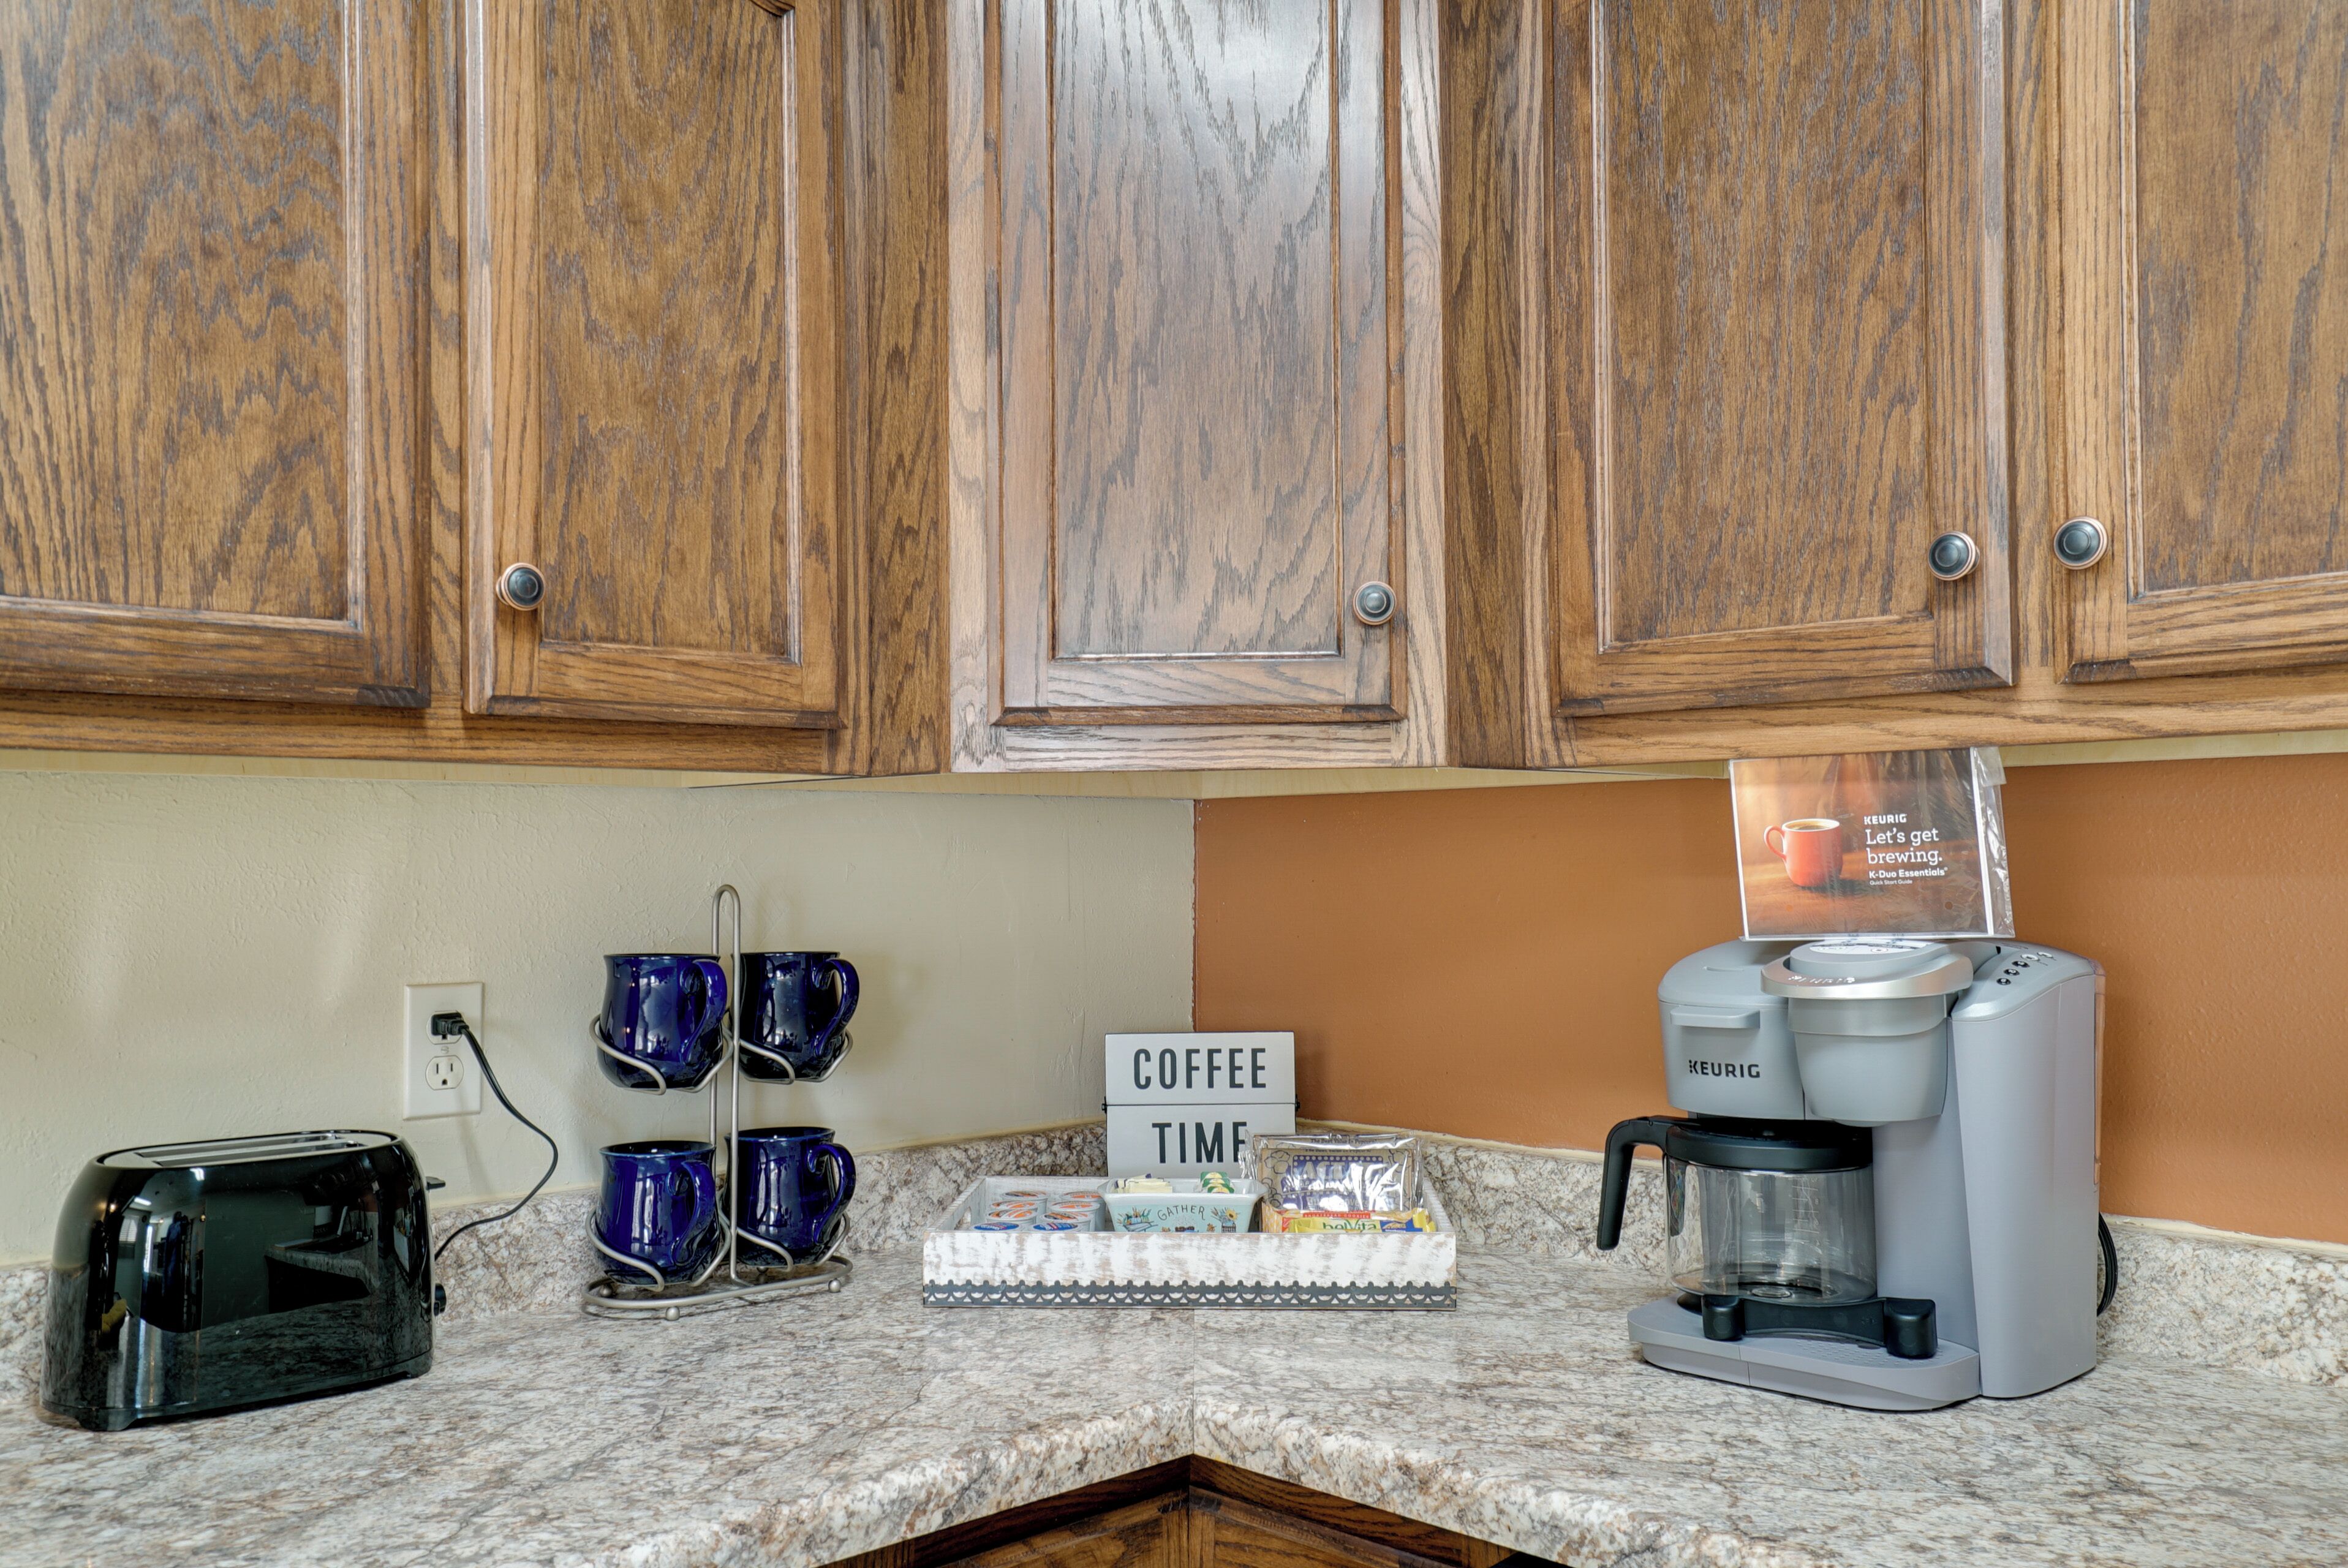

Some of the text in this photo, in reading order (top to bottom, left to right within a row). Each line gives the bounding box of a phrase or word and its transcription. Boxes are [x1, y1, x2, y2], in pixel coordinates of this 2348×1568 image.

[1863, 813, 1907, 825] KEURIG
[1865, 827, 1939, 846] Let's get
[1866, 847, 1942, 865] brewing.
[1869, 870, 1897, 878] K-Duo
[1133, 1048, 1266, 1090] COFFEE
[1689, 1060, 1761, 1078] KEURIG
[1152, 1121, 1247, 1164] TIME
[1157, 1204, 1206, 1221] GATHER
